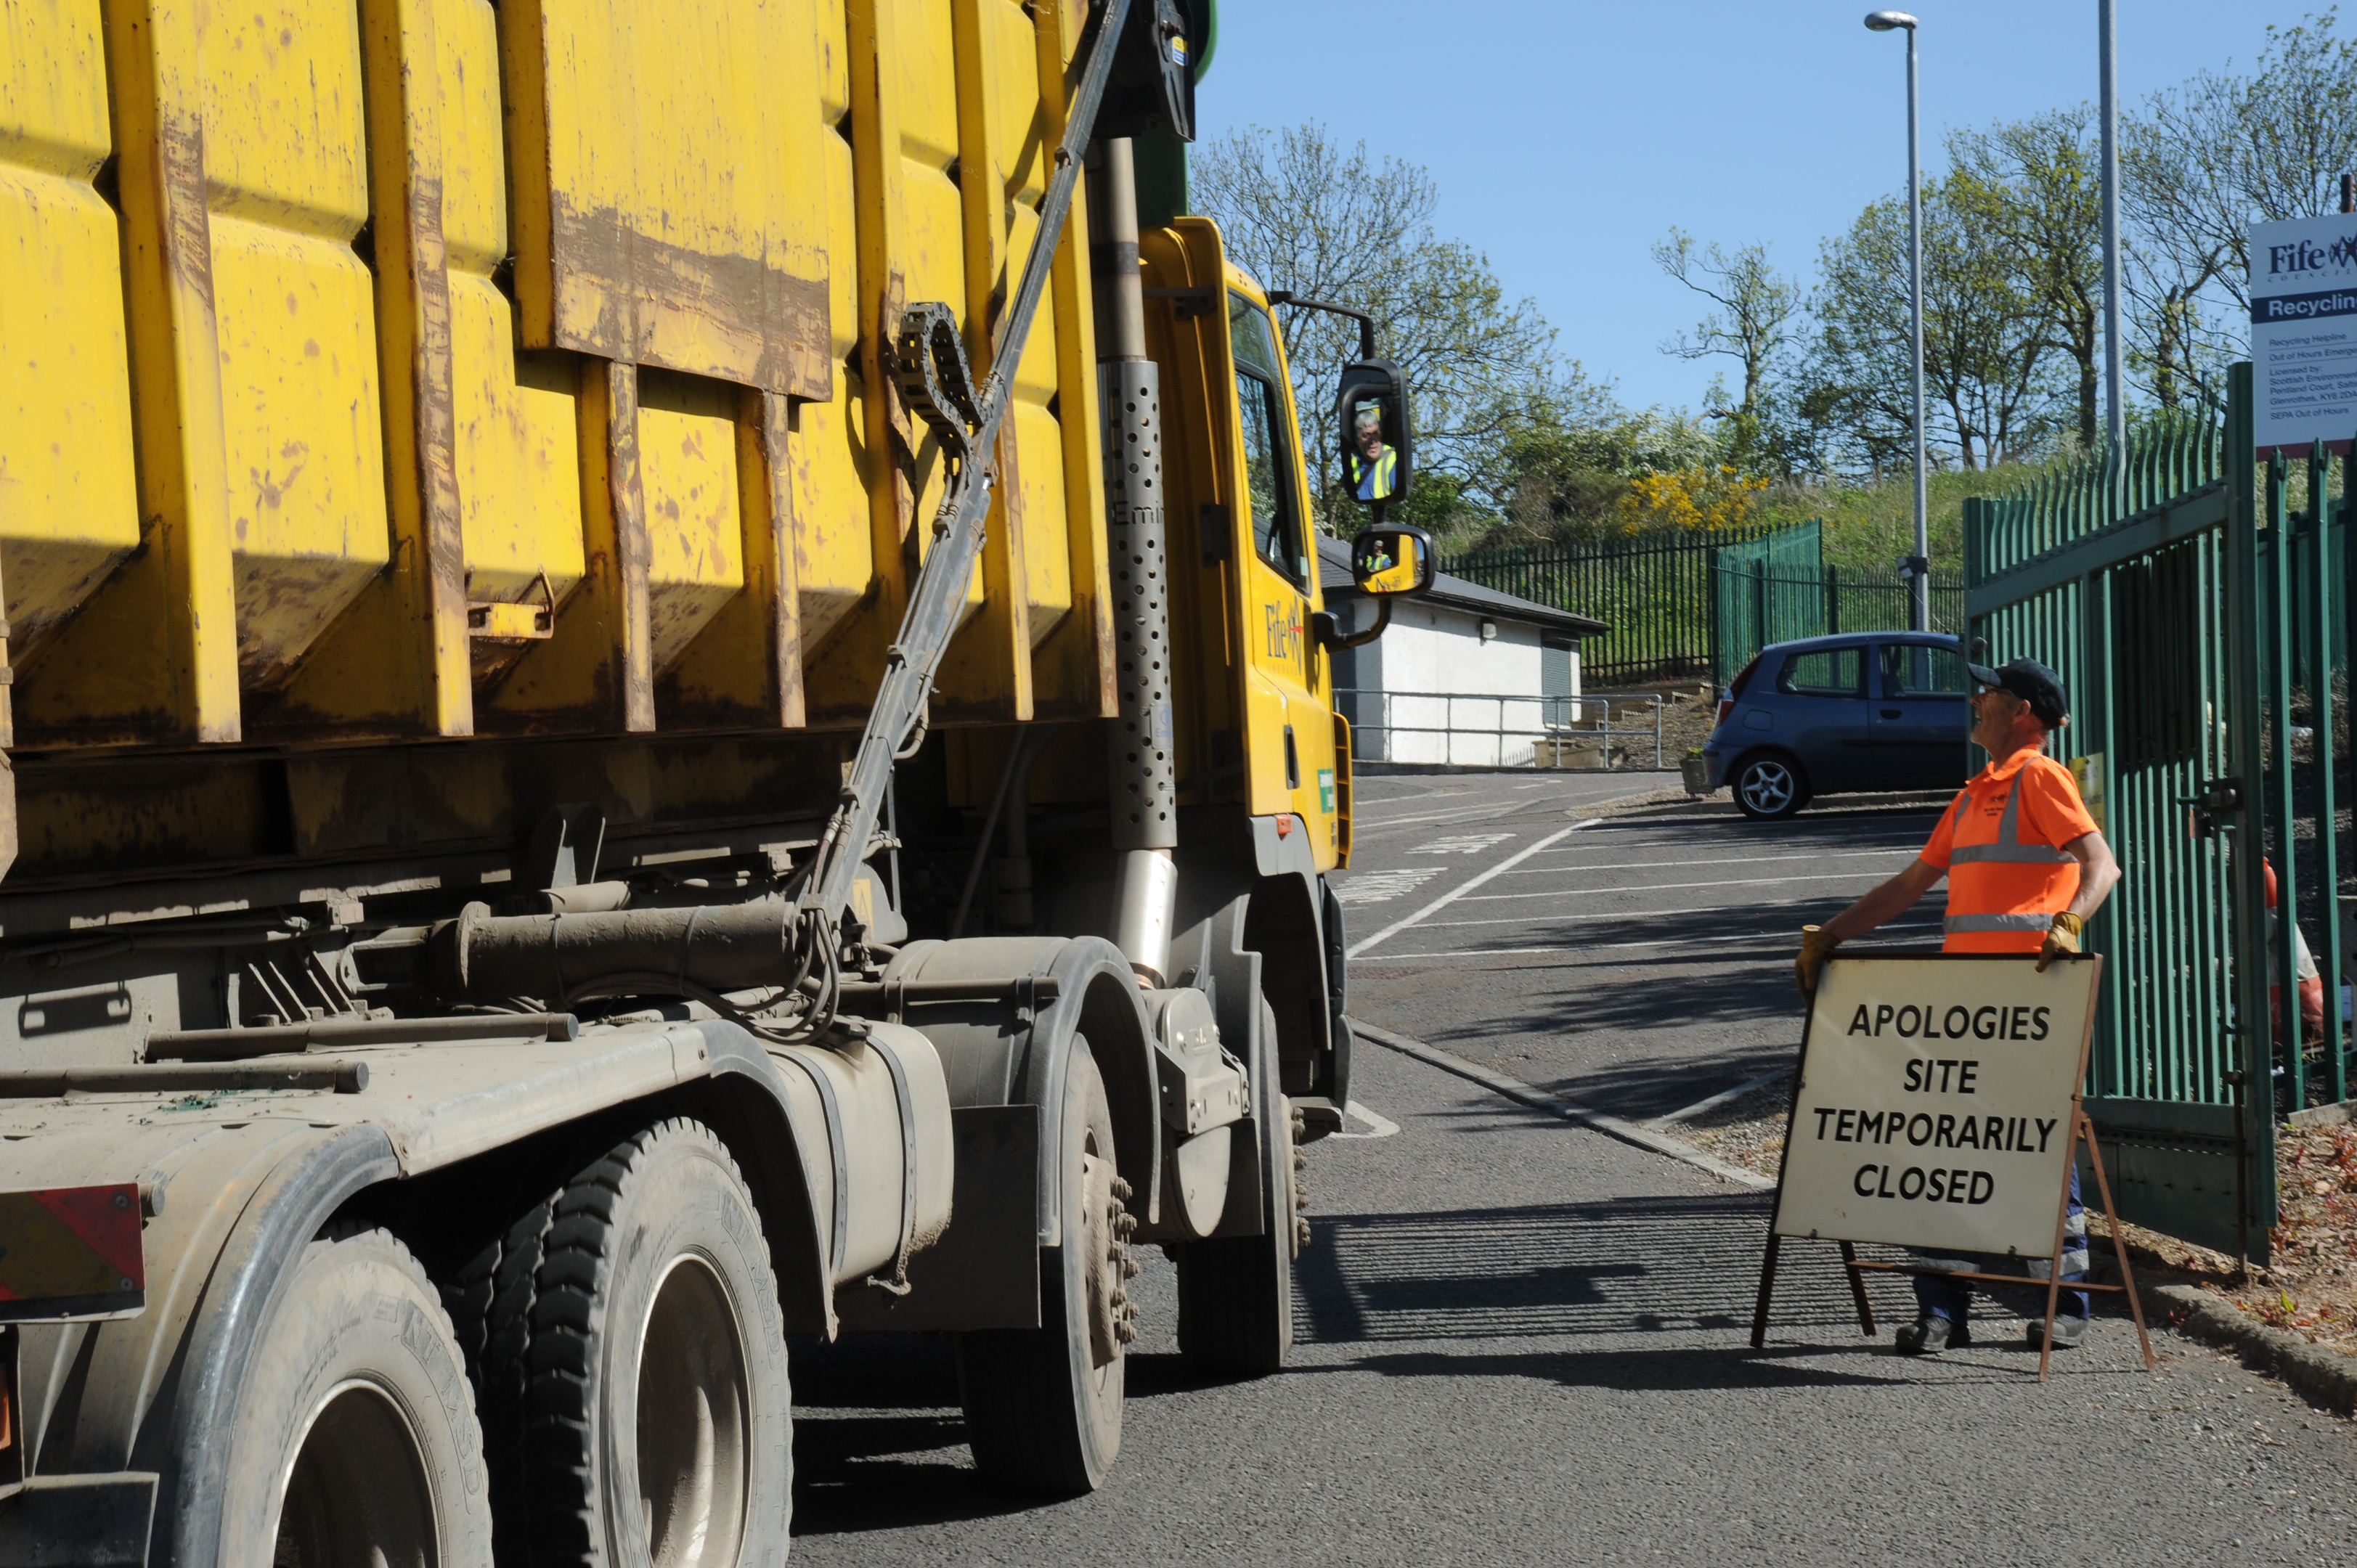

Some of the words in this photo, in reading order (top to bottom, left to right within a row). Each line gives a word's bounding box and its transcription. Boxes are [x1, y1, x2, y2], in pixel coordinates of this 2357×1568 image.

[2268, 240, 2326, 274] Fife
[2268, 293, 2357, 317] Recyclin
[2268, 336, 2310, 347] Recycling
[2312, 333, 2347, 343] Helpline
[2269, 365, 2307, 376] Licensed
[2270, 376, 2304, 385] Scottish
[2270, 385, 2307, 395] Pentland
[2270, 411, 2293, 420] SEPA
[2295, 409, 2311, 418] Out
[1265, 600, 1287, 659] Fife
[1847, 1003, 2051, 1041] APOLOGIES
[1903, 1058, 1979, 1095] SITE
[1813, 1107, 2058, 1153] TEMPORARILY
[1853, 1164, 1995, 1205] CLOSED
